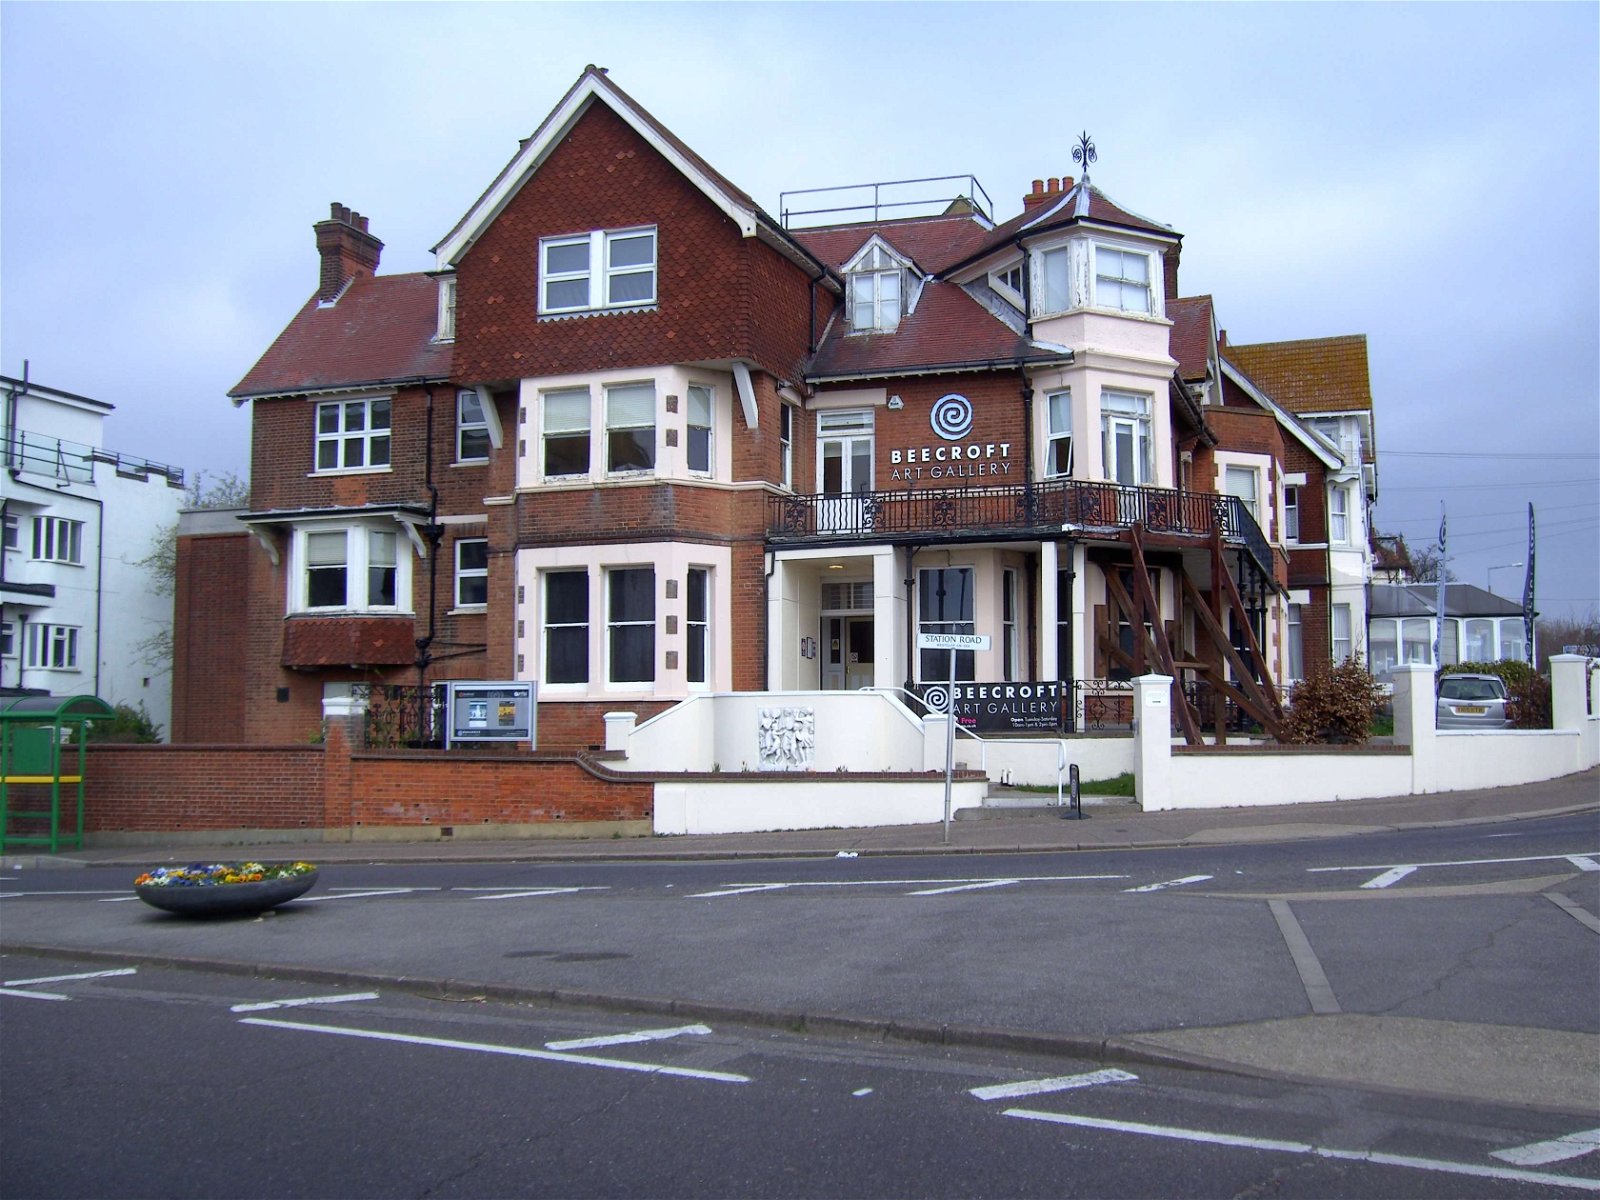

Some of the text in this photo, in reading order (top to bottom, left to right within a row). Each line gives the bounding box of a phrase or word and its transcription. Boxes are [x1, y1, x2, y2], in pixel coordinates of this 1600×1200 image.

[891, 443, 1010, 464] BEECROFT
[891, 462, 1011, 481] ART GALLERY
[925, 634, 982, 644] STATION ROAD
[953, 685, 1057, 699] BEECROFT
[953, 701, 1057, 714] ART GALLERY
